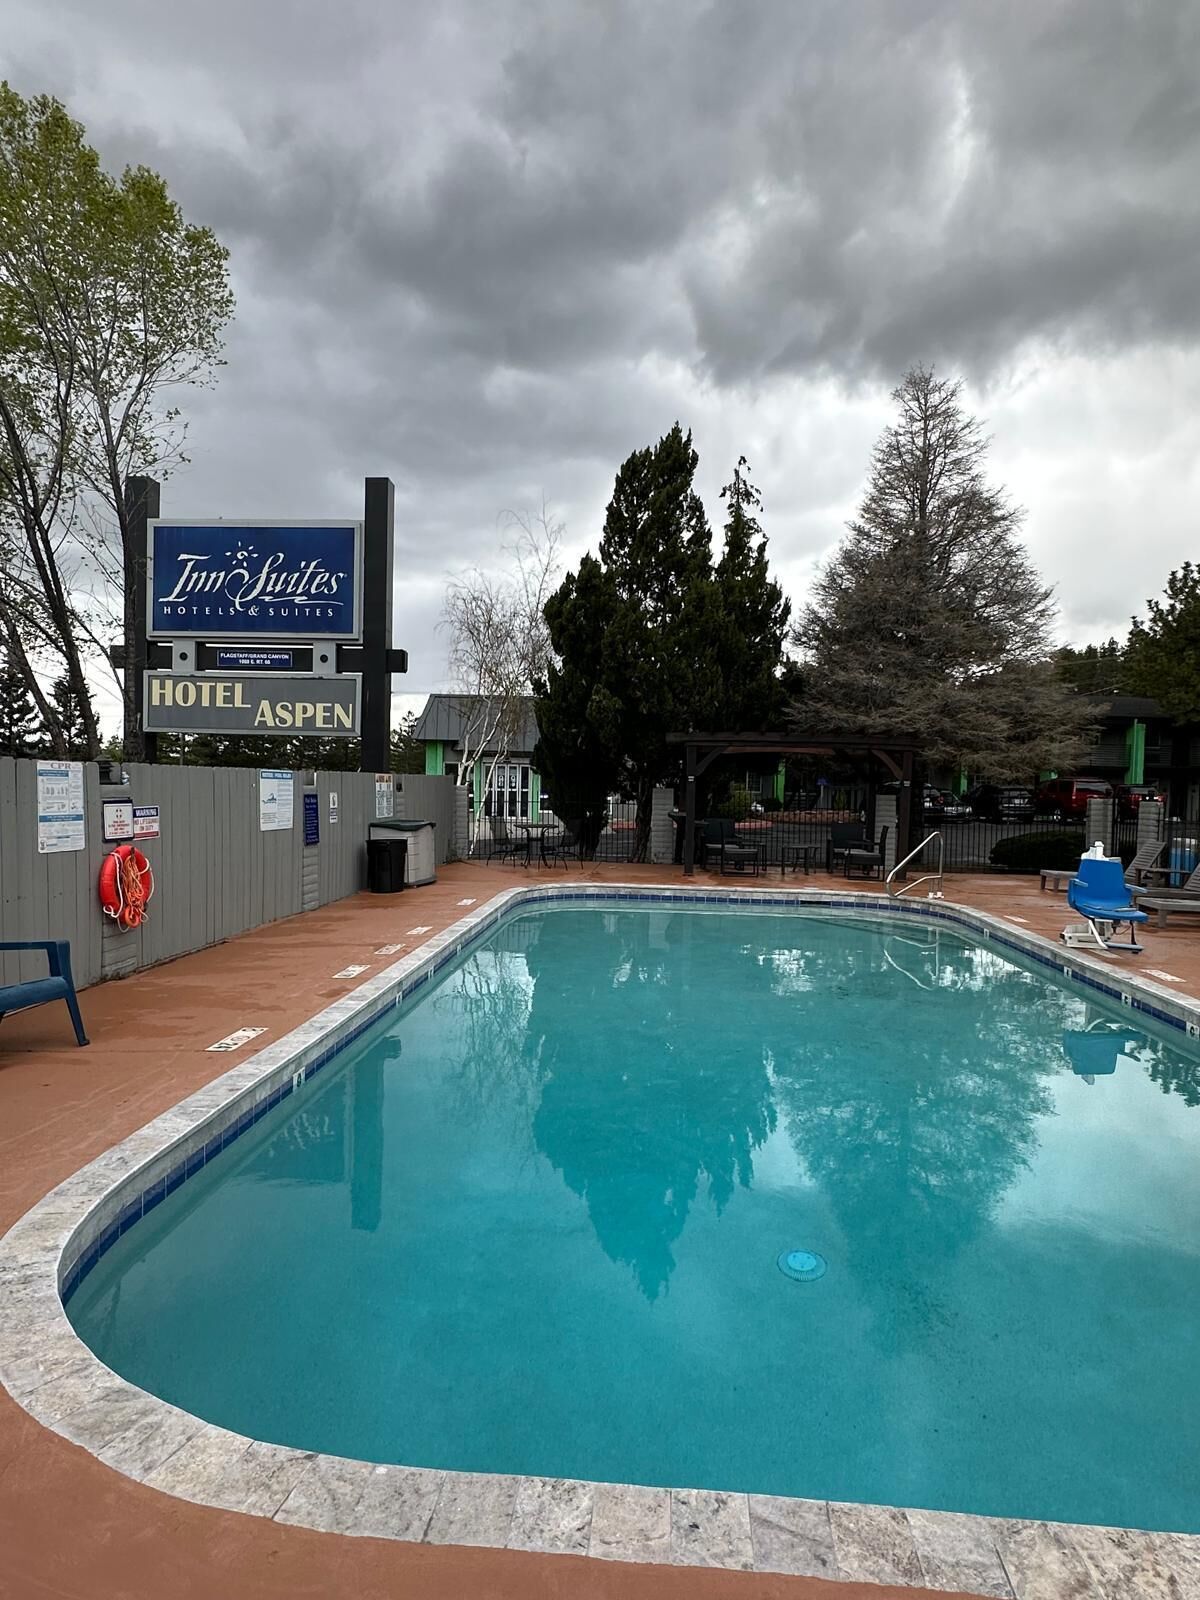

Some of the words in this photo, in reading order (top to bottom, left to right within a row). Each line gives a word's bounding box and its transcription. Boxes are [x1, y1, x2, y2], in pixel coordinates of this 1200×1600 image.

[163, 606, 236, 616] HOTELS
[248, 605, 260, 617] &
[269, 607, 334, 617] SUITES
[151, 679, 252, 708] HOTEL
[254, 699, 353, 729] ASPEN
[135, 808, 157, 817] WARNING
